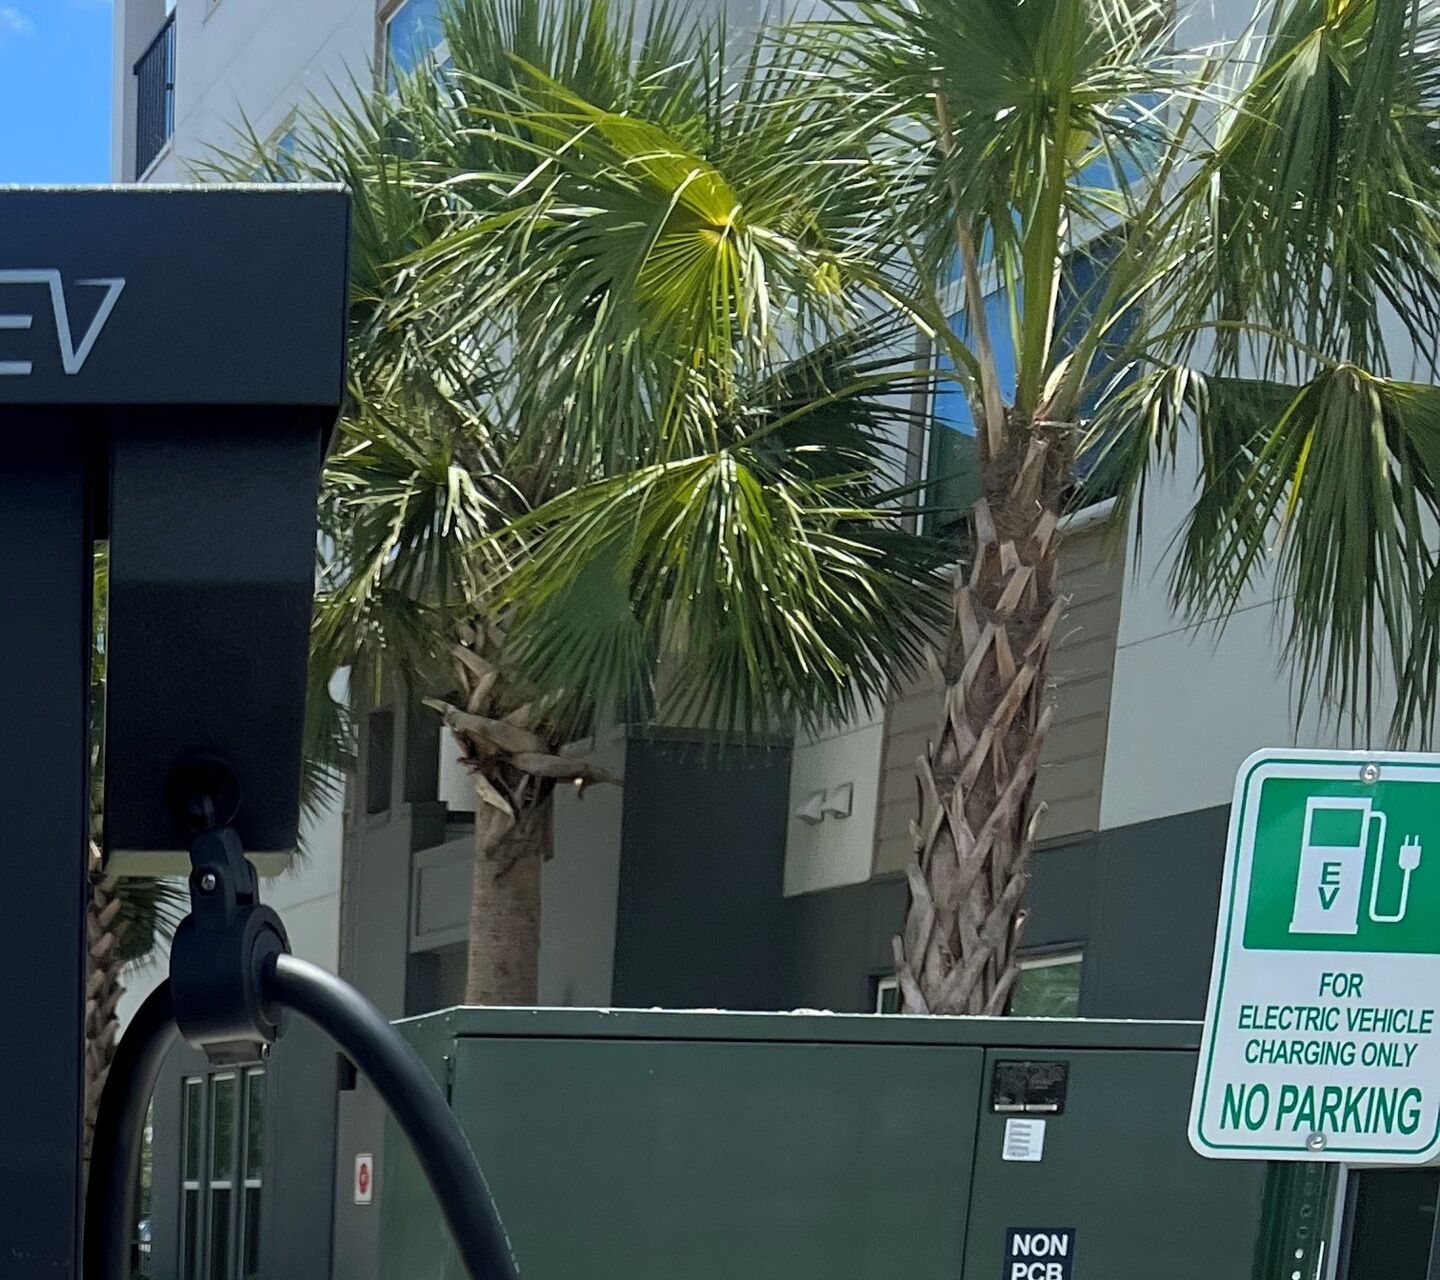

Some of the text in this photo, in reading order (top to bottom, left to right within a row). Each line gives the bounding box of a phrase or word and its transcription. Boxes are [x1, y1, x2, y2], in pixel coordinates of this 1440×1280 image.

[1318, 972, 1364, 998] FOR
[1238, 1004, 1435, 1034] ELECTRIC VEHICLE
[1244, 1038, 1419, 1067] CHARGING ONLY
[1219, 1082, 1423, 1136] NO PARKING
[1011, 1233, 1069, 1257] NON
